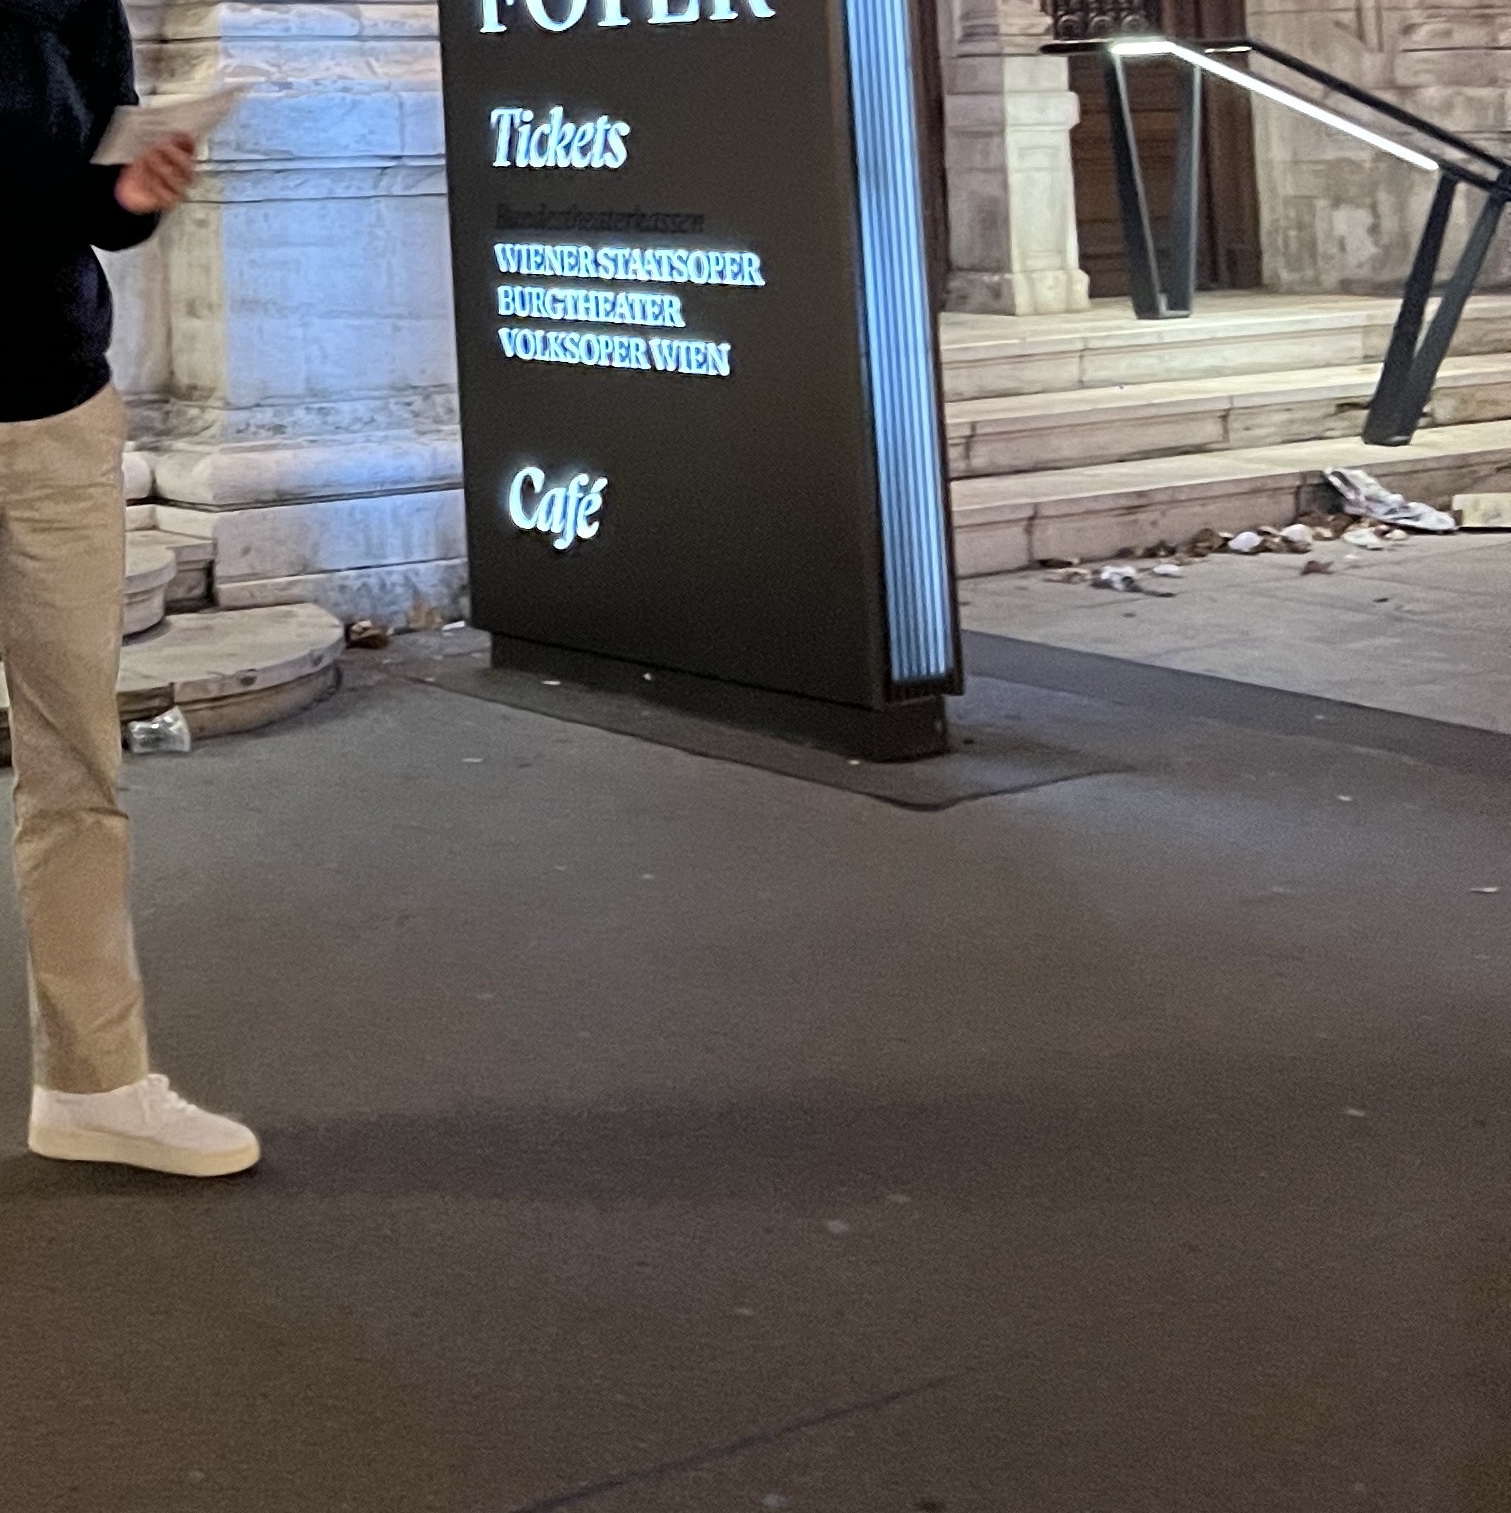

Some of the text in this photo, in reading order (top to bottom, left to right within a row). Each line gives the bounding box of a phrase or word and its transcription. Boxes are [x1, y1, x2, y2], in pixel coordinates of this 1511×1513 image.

[490, 105, 631, 169] Tickets
[494, 243, 766, 287] WIENER STAATSOPER
[496, 285, 687, 328] BURGTHEATER
[498, 327, 732, 377] VOLKSOPER WIEN
[509, 466, 608, 550] Café
